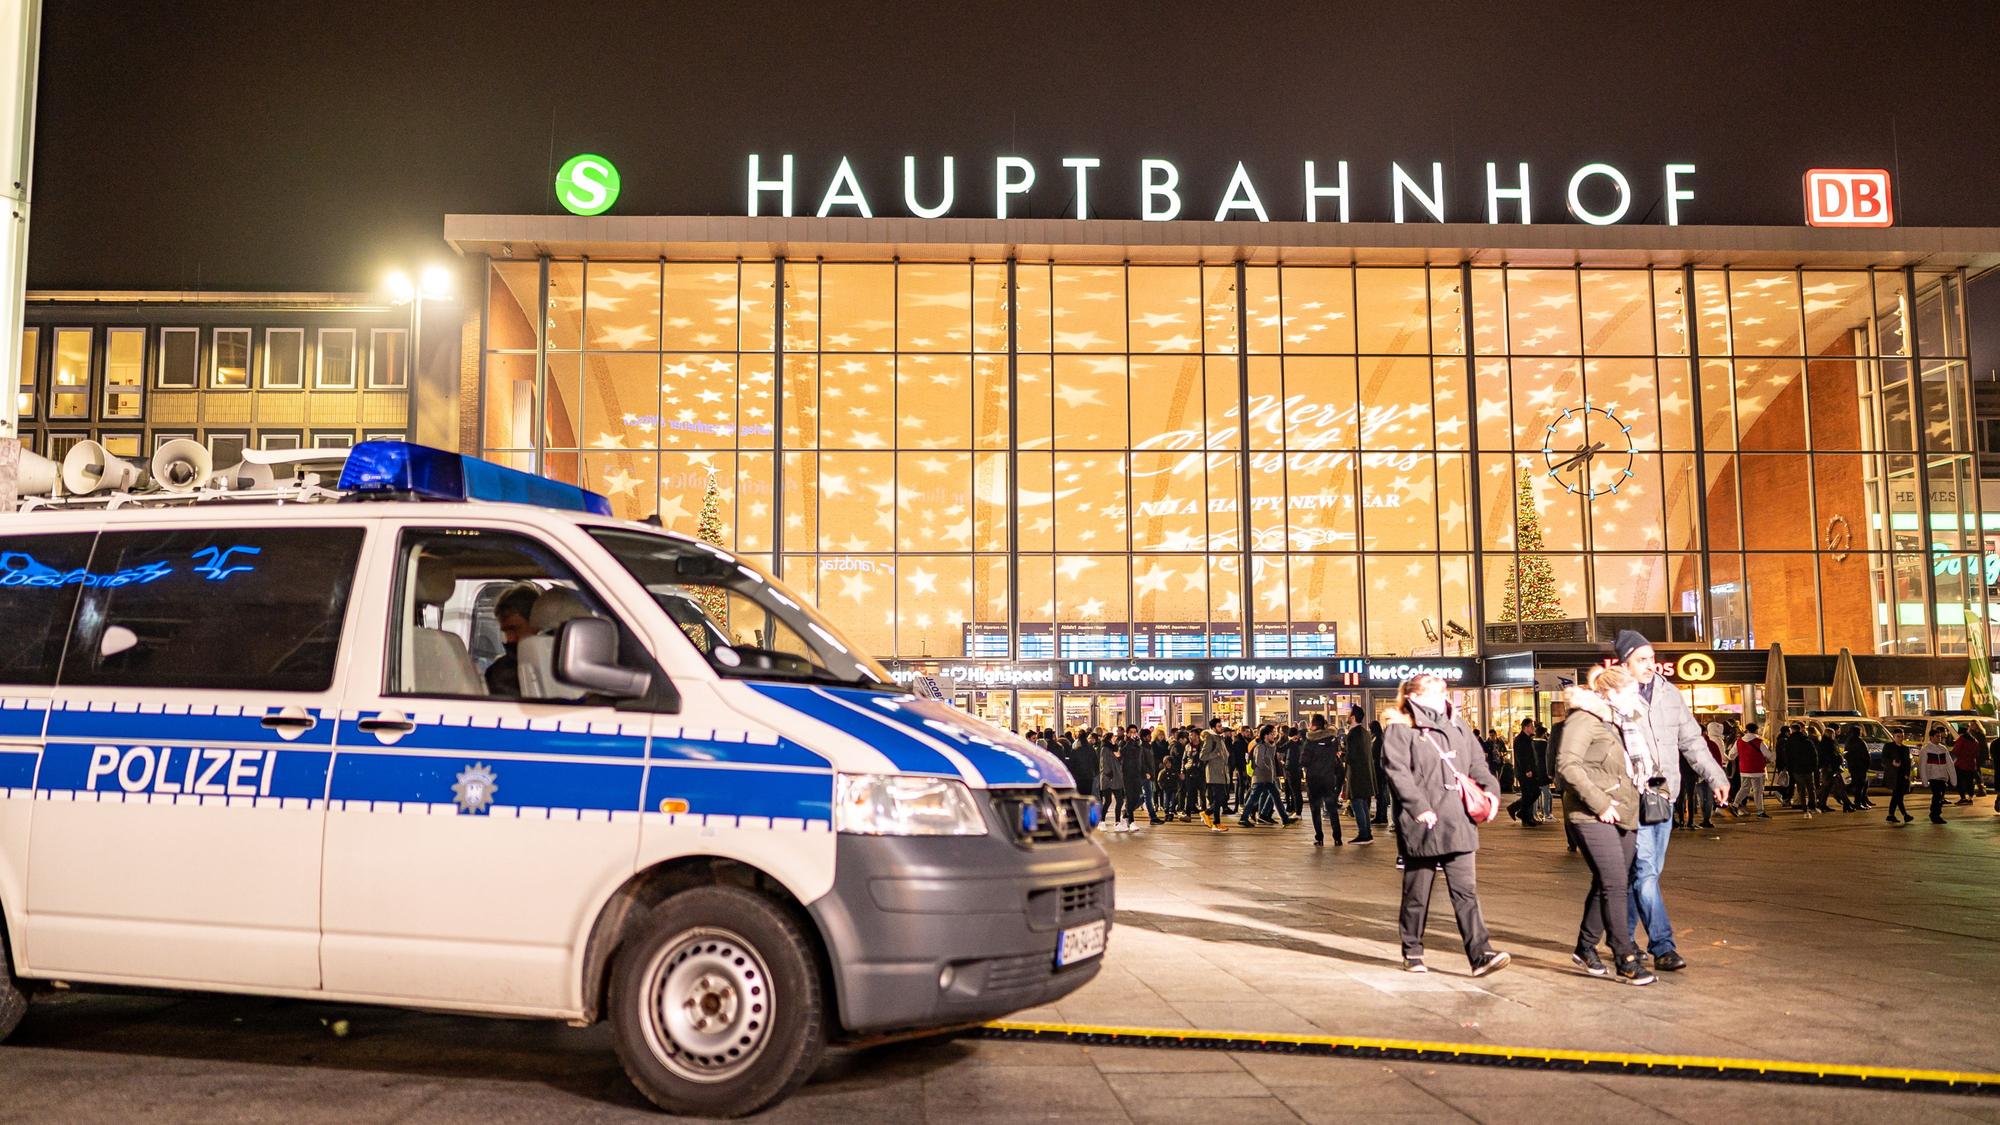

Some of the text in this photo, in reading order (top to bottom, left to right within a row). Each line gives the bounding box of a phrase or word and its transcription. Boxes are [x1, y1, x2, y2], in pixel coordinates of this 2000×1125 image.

[566, 160, 612, 210] S
[747, 153, 1696, 226] HAUPTBAHNHOF
[1816, 178, 1884, 220] DB
[1224, 394, 1413, 434] Merry
[1118, 427, 1428, 477] Christmas
[1207, 495, 1283, 513] HAPPY
[1287, 495, 1337, 510] NEW
[1343, 493, 1401, 509] YEAR
[1895, 491, 1956, 502] HEMES
[968, 667, 1054, 684] Highspeed
[1099, 666, 1195, 684] NetCologne
[1239, 665, 1324, 683] Highspeed
[86, 746, 277, 797] POLIZEI
